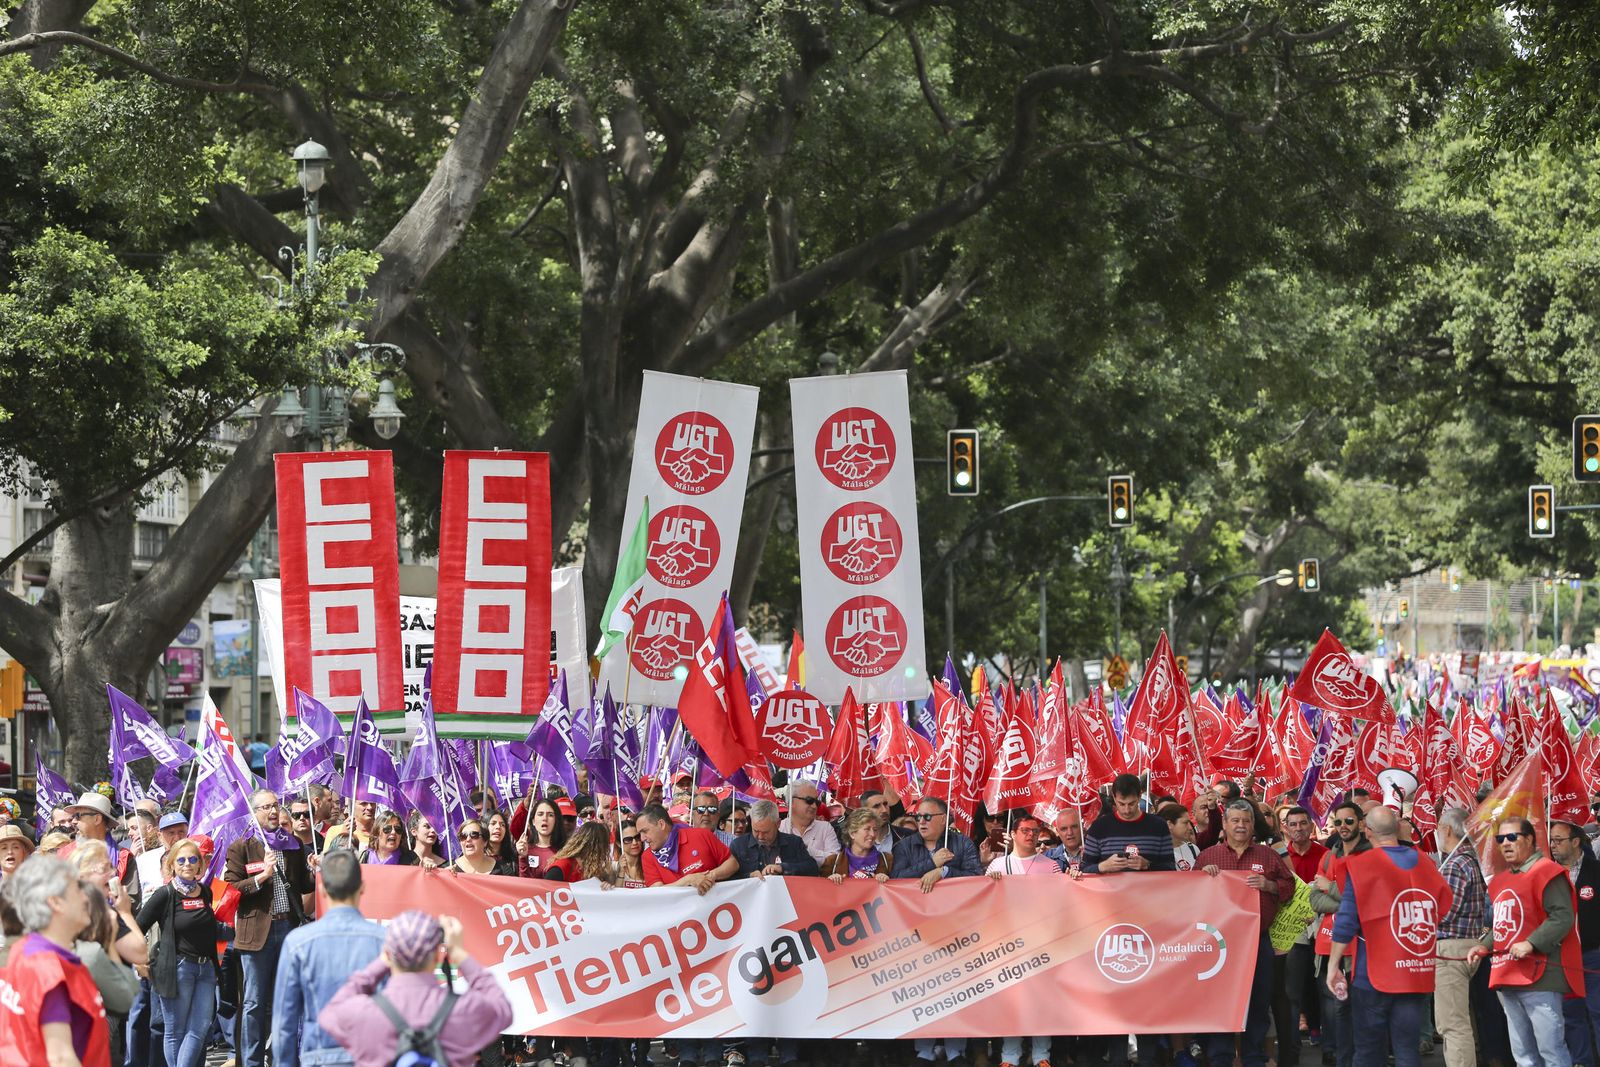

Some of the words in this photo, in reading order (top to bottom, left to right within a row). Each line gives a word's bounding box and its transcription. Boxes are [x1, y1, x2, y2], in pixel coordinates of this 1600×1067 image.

[673, 423, 719, 453] UGT
[832, 419, 876, 445] UGT
[674, 481, 706, 493] Málaga
[841, 478, 875, 489] Málaga
[658, 516, 706, 546] UGT
[837, 513, 883, 541] UGT
[659, 575, 692, 587] Málaga
[847, 572, 880, 583] Málaga
[645, 609, 691, 639] UGT
[841, 607, 888, 635] UGT
[643, 667, 675, 679] Málaga
[851, 664, 884, 675] Málaga
[766, 699, 820, 729] UGT
[772, 748, 814, 761] Andalucía
[1002, 719, 1031, 771] UGT
[486, 887, 575, 929] mayo
[1398, 901, 1434, 928] UGT
[496, 909, 585, 962] 2018
[1102, 933, 1146, 958] UGT
[1159, 941, 1214, 954] Andalucía
[508, 902, 743, 1016] Tiempo
[655, 971, 724, 1022] de
[738, 895, 884, 995] ganar
[851, 928, 922, 972] Igualdad
[871, 956, 921, 988] Mejor
[922, 929, 981, 967] empleo
[1159, 954, 1187, 962] MÁLAGA
[891, 966, 962, 1005] Mayores
[963, 934, 1026, 974] salarios
[912, 979, 995, 1022] Pensiones
[997, 950, 1052, 986] dignas
